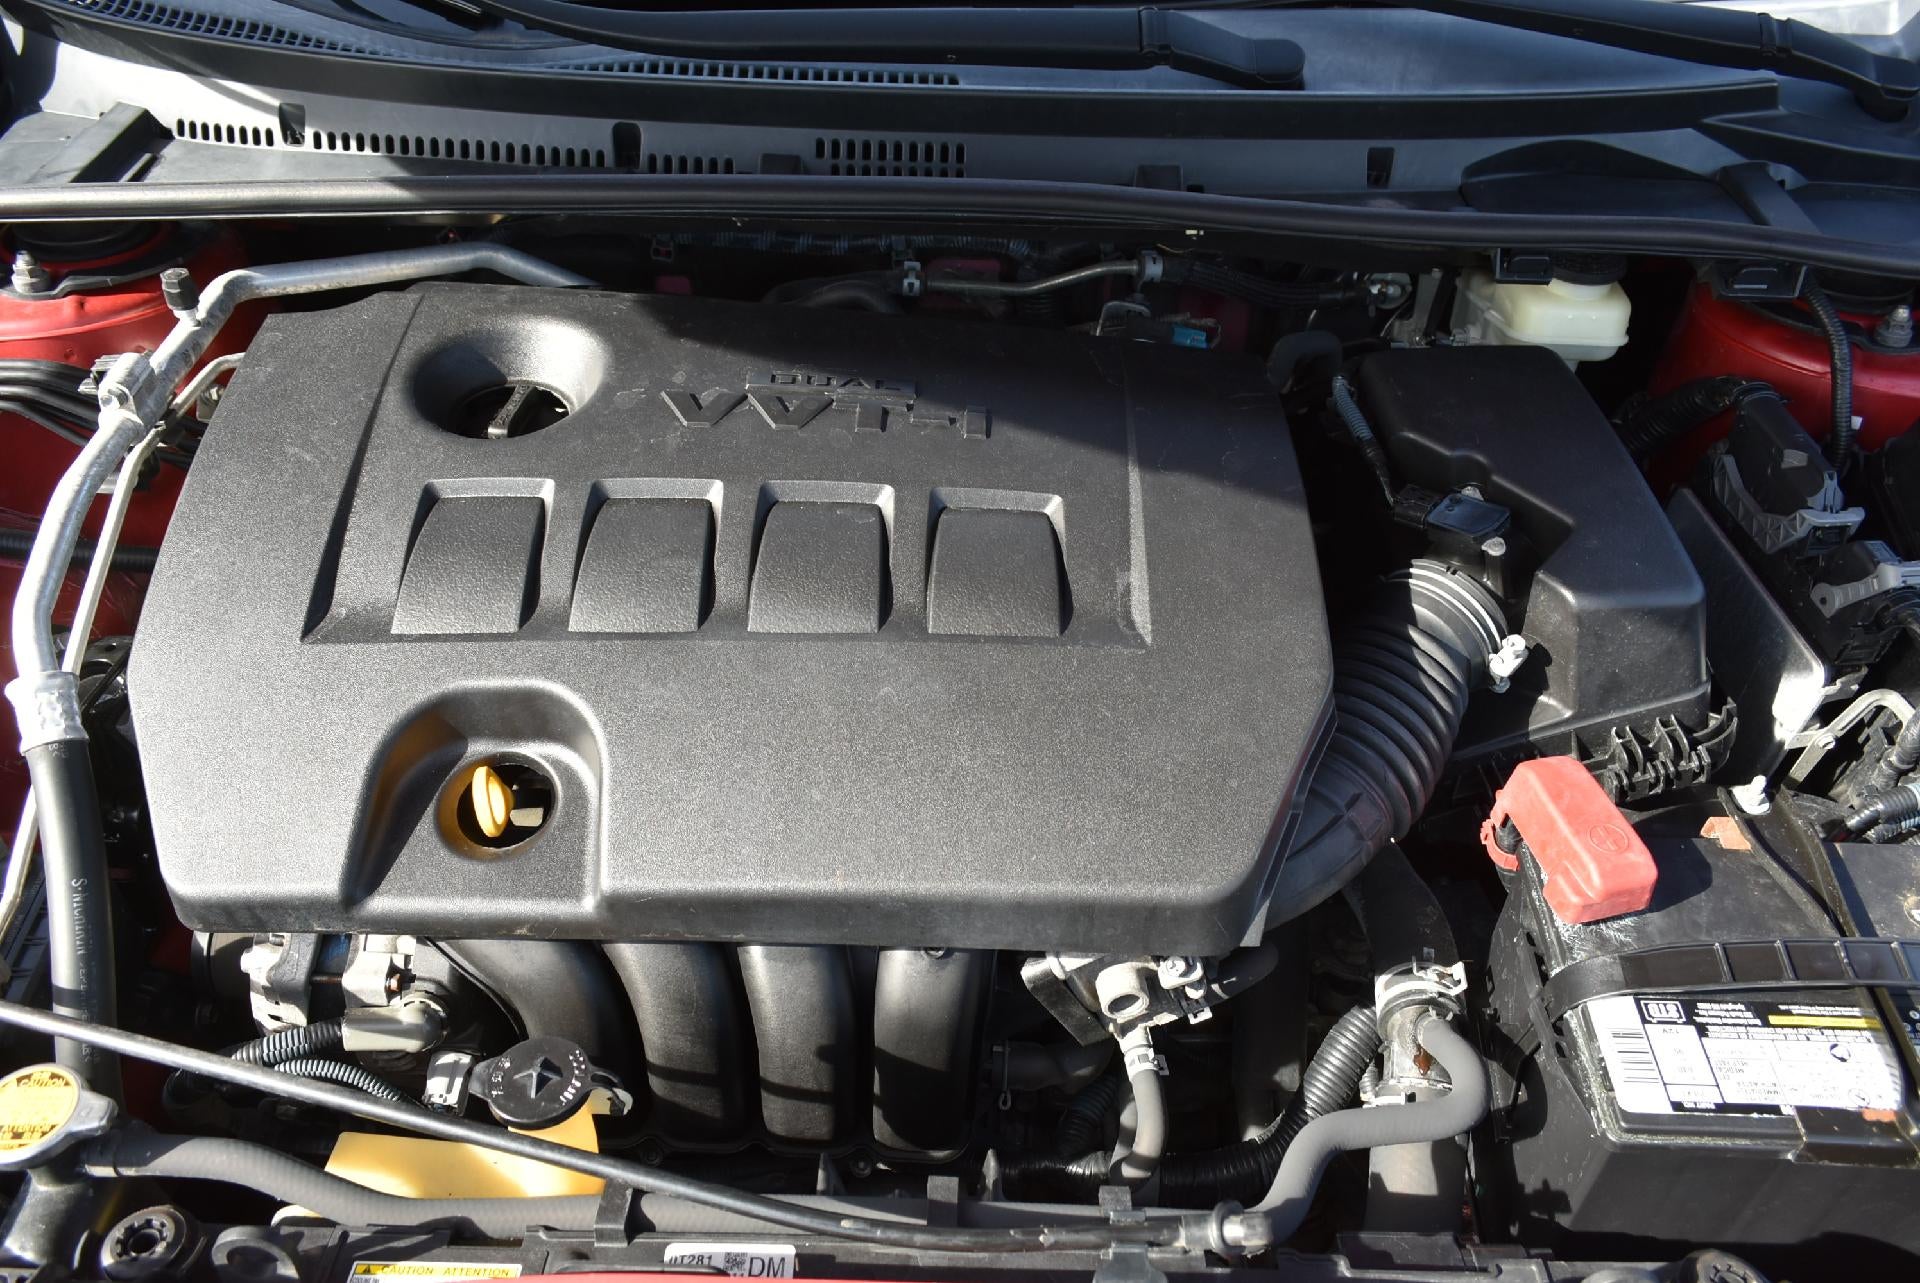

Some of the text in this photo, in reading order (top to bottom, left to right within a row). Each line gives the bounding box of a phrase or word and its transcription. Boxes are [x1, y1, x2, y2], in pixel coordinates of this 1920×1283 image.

[769, 372, 904, 391] DUAL
[381, 1264, 510, 1278] CAUTION ATTENTION
[748, 1256, 786, 1278] DM
